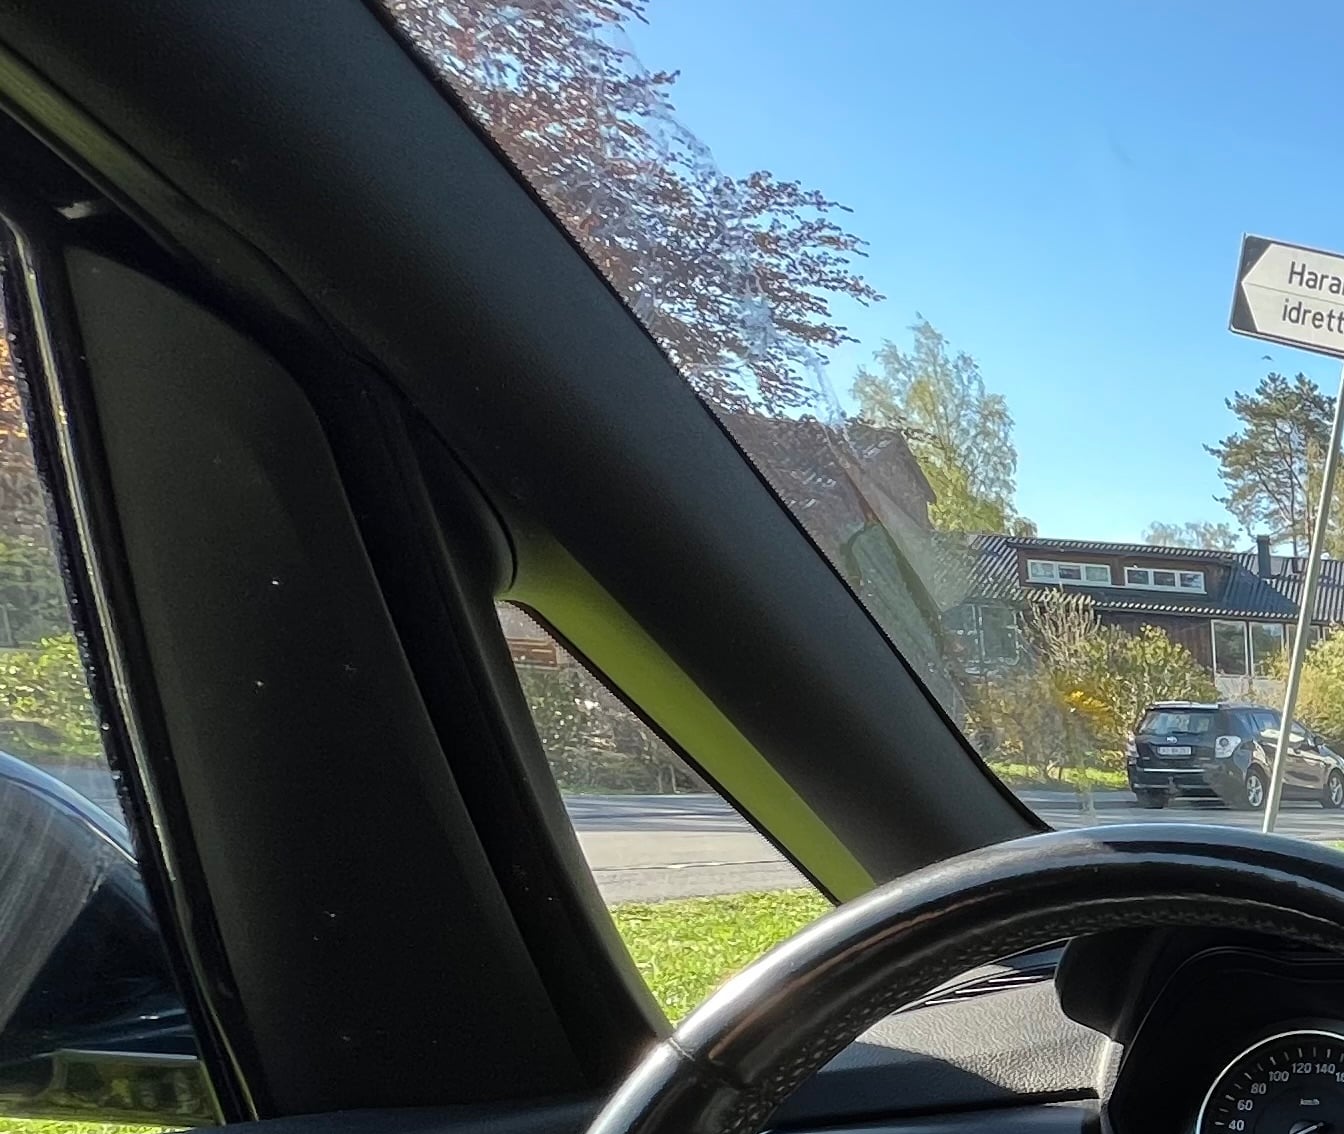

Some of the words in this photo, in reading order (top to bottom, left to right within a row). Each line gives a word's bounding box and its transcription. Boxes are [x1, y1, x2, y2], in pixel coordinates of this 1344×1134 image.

[1292, 1063, 1312, 1074] 120
[1315, 1064, 1336, 1075] 140
[1269, 1071, 1290, 1082] 100
[1251, 1083, 1267, 1095] 80
[1237, 1100, 1253, 1111] 60
[1228, 1120, 1245, 1131] 40
